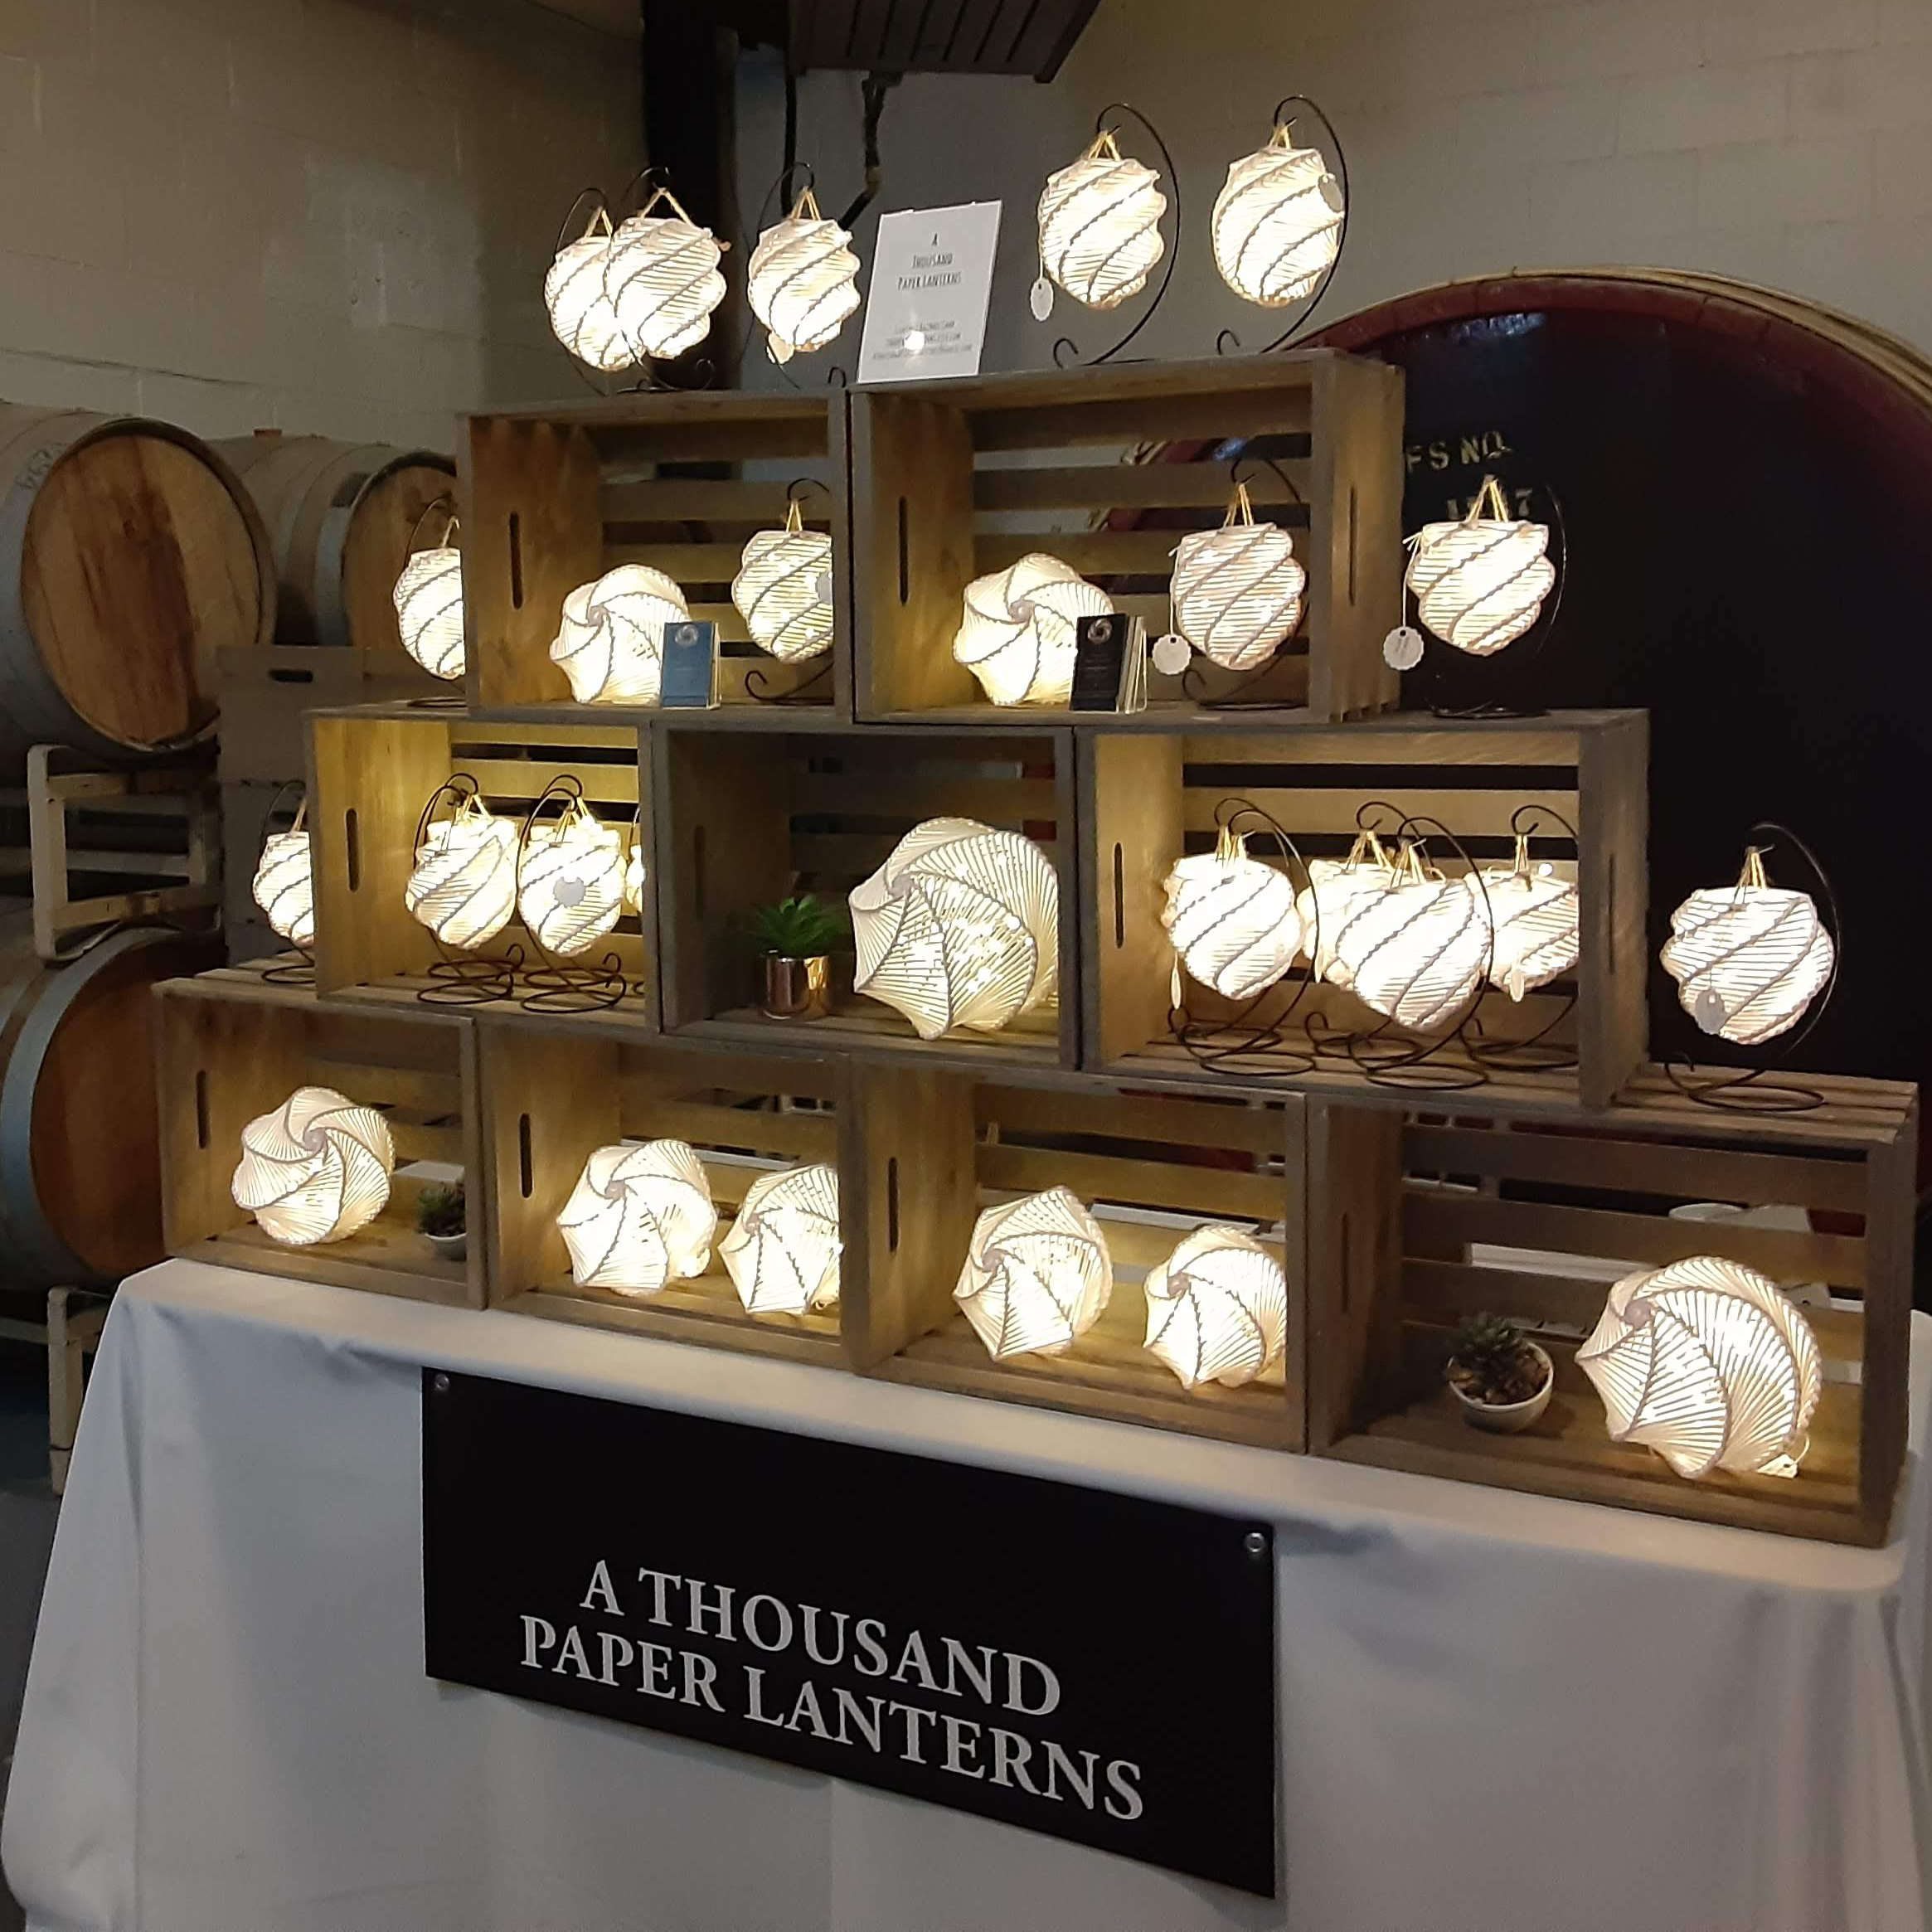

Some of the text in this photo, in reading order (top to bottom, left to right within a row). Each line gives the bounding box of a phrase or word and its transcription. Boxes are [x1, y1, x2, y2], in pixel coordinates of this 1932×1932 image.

[931, 233, 939, 246] A
[912, 253, 954, 269] THOUSAND
[898, 271, 962, 290] PAPER LANTERNS
[579, 1559, 1061, 1716] A THOUSAND
[520, 1614, 1143, 1821] PAPER LANTERNS
